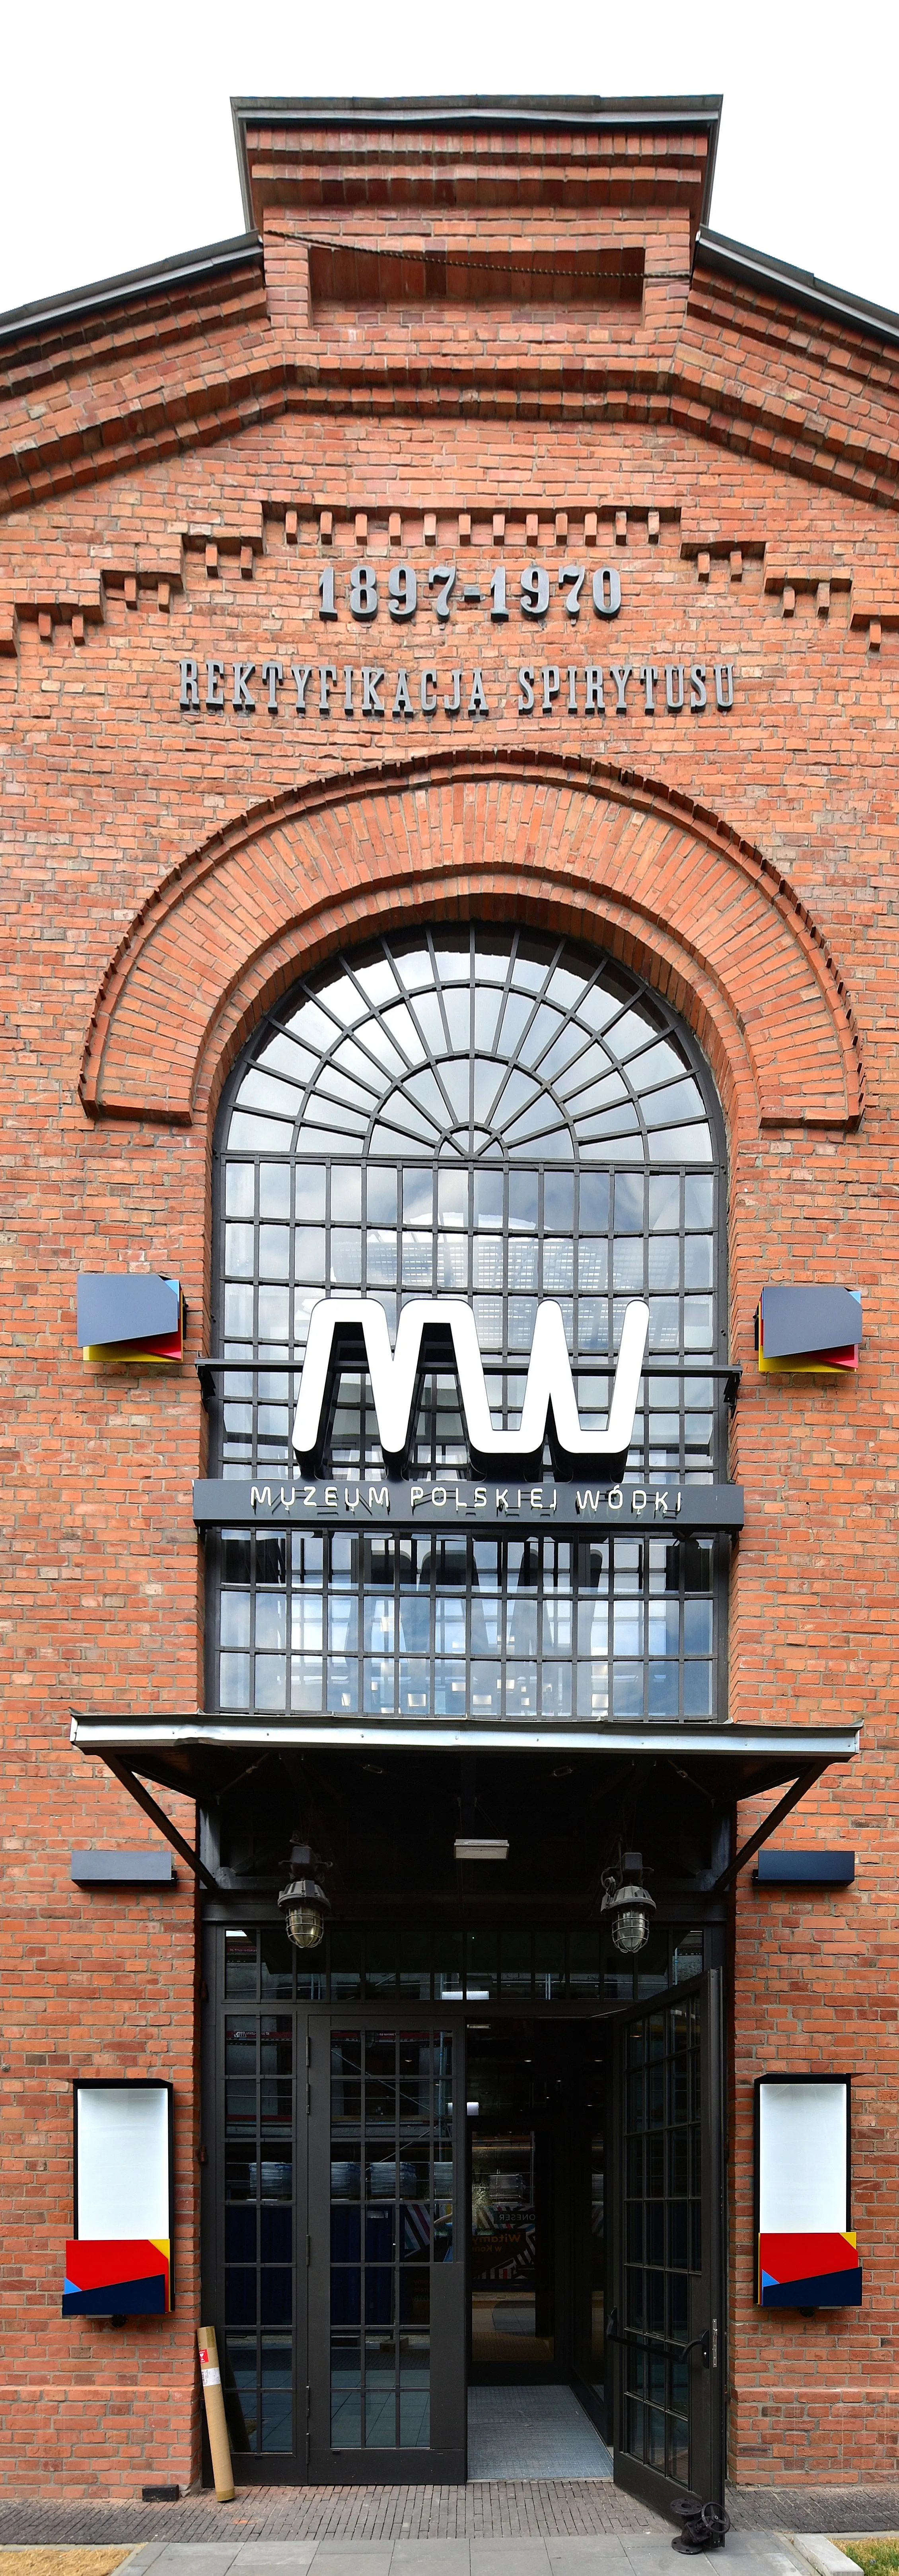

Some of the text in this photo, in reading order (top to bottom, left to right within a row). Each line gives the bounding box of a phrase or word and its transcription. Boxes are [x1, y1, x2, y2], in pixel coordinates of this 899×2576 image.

[319, 565, 622, 621] 1897-1970
[179, 658, 734, 717] REKTYFIKACJA SPIRYTUSU
[250, 1485, 681, 1511] MUZEUM POLSKIEJ WÓDKI
